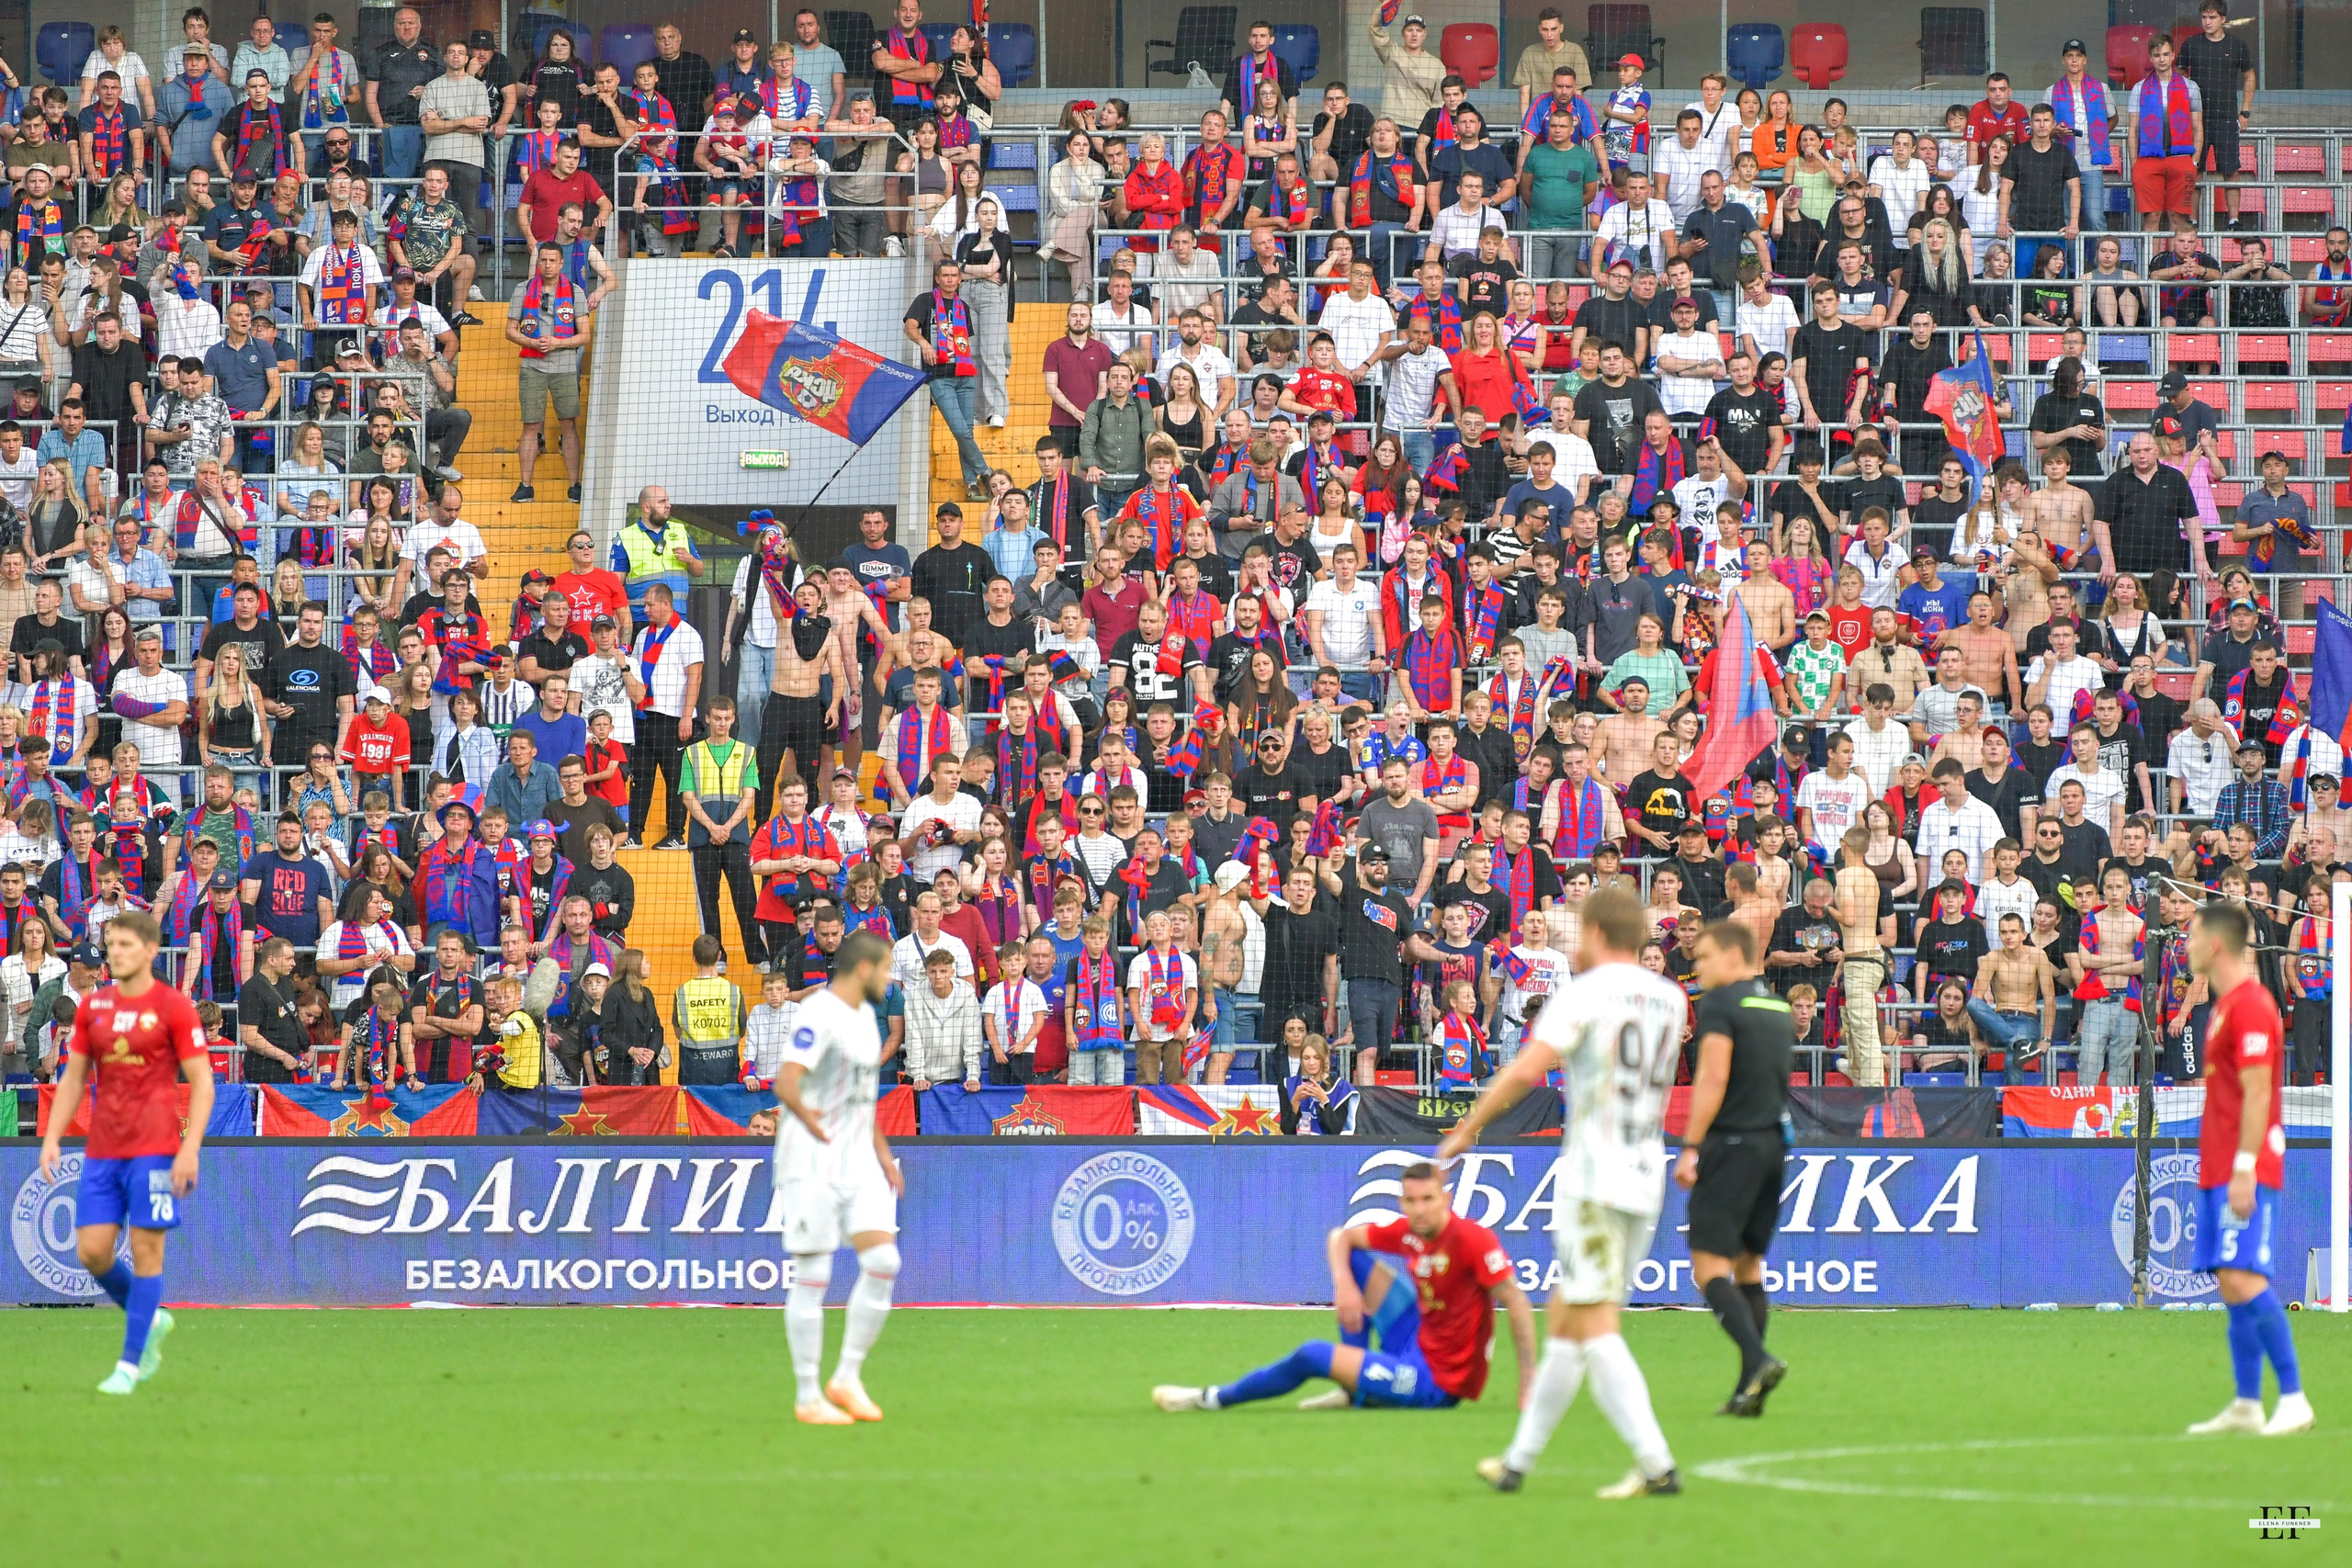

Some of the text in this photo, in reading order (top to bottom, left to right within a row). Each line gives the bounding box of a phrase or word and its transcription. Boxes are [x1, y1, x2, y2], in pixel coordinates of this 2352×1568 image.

[350, 265, 362, 288] ПФК
[705, 404, 775, 427] Выход
[745, 453, 785, 467] ВЫХОД
[861, 564, 889, 573] TOMMY
[568, 603, 603, 621] СКА
[1132, 643, 1161, 652] AUTHE
[361, 742, 392, 759] 1984
[273, 867, 307, 893] RED
[175, 876, 189, 940] МОСКВА
[272, 891, 305, 912] BLUE
[689, 998, 728, 1010] SAFETY
[693, 1017, 728, 1030] K0702
[693, 1047, 735, 1062] STEWARD
[2182, 1025, 2196, 1075] adidas
[2050, 1085, 2097, 1100] ОДНИ
[383, 1156, 900, 1234] БАЛТИ
[1057, 1155, 1191, 1222] БЕЗАЛКОГОЛЬНАЯ
[1443, 1154, 1979, 1234] БАИКА
[149, 1192, 175, 1223] 78
[2220, 1228, 2239, 1263] 5
[406, 1258, 800, 1291] БЕЗАЛКОГОЛЬНОЕ
[1069, 1252, 1178, 1291] ПРОДУКЦИЯ
